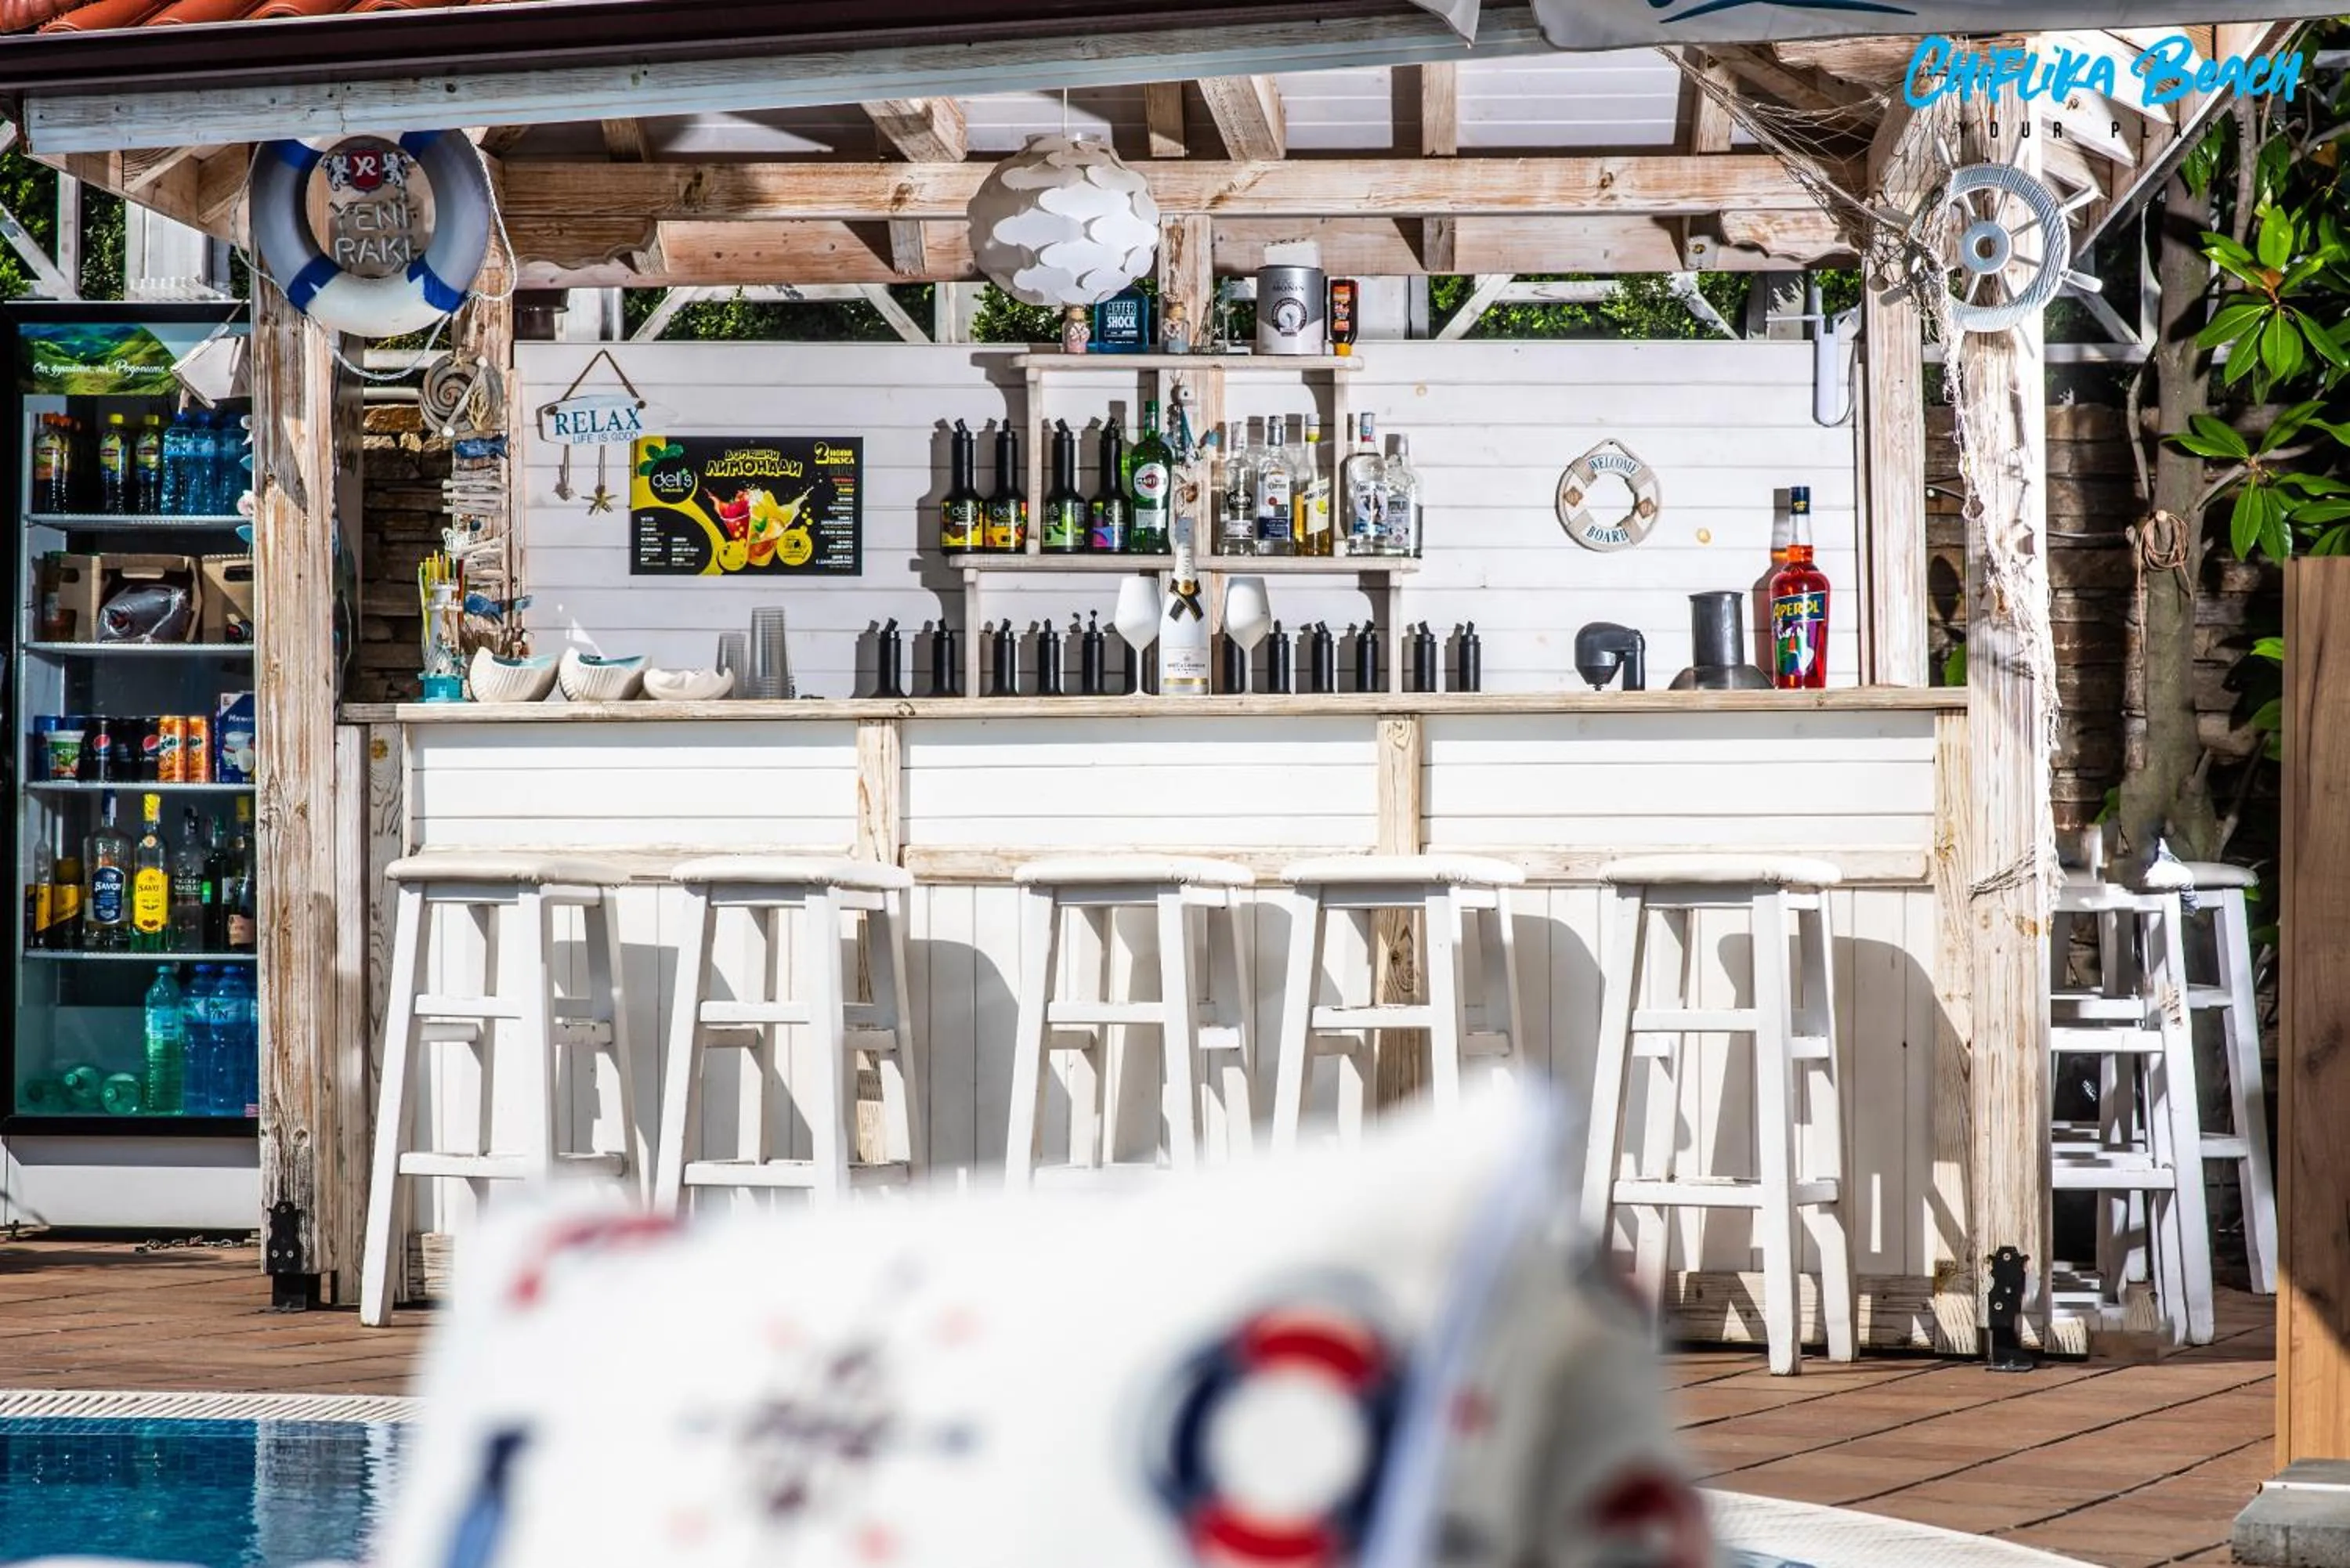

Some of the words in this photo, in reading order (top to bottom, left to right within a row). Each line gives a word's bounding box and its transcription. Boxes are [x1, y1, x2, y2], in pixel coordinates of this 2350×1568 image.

[1106, 301, 1137, 315] AFTER
[1107, 316, 1137, 328] SHOCK
[555, 408, 642, 435] RELAX
[573, 433, 594, 444] LIFE
[598, 433, 608, 443] IS
[611, 431, 638, 442] GOOD
[815, 441, 829, 464] 2
[705, 458, 803, 478] ЛИМОНАДИ
[1589, 457, 1638, 474] WELCOME
[1135, 476, 1166, 485] MARTII
[1586, 526, 1629, 543] BOARD
[1773, 599, 1820, 620] APEROL
